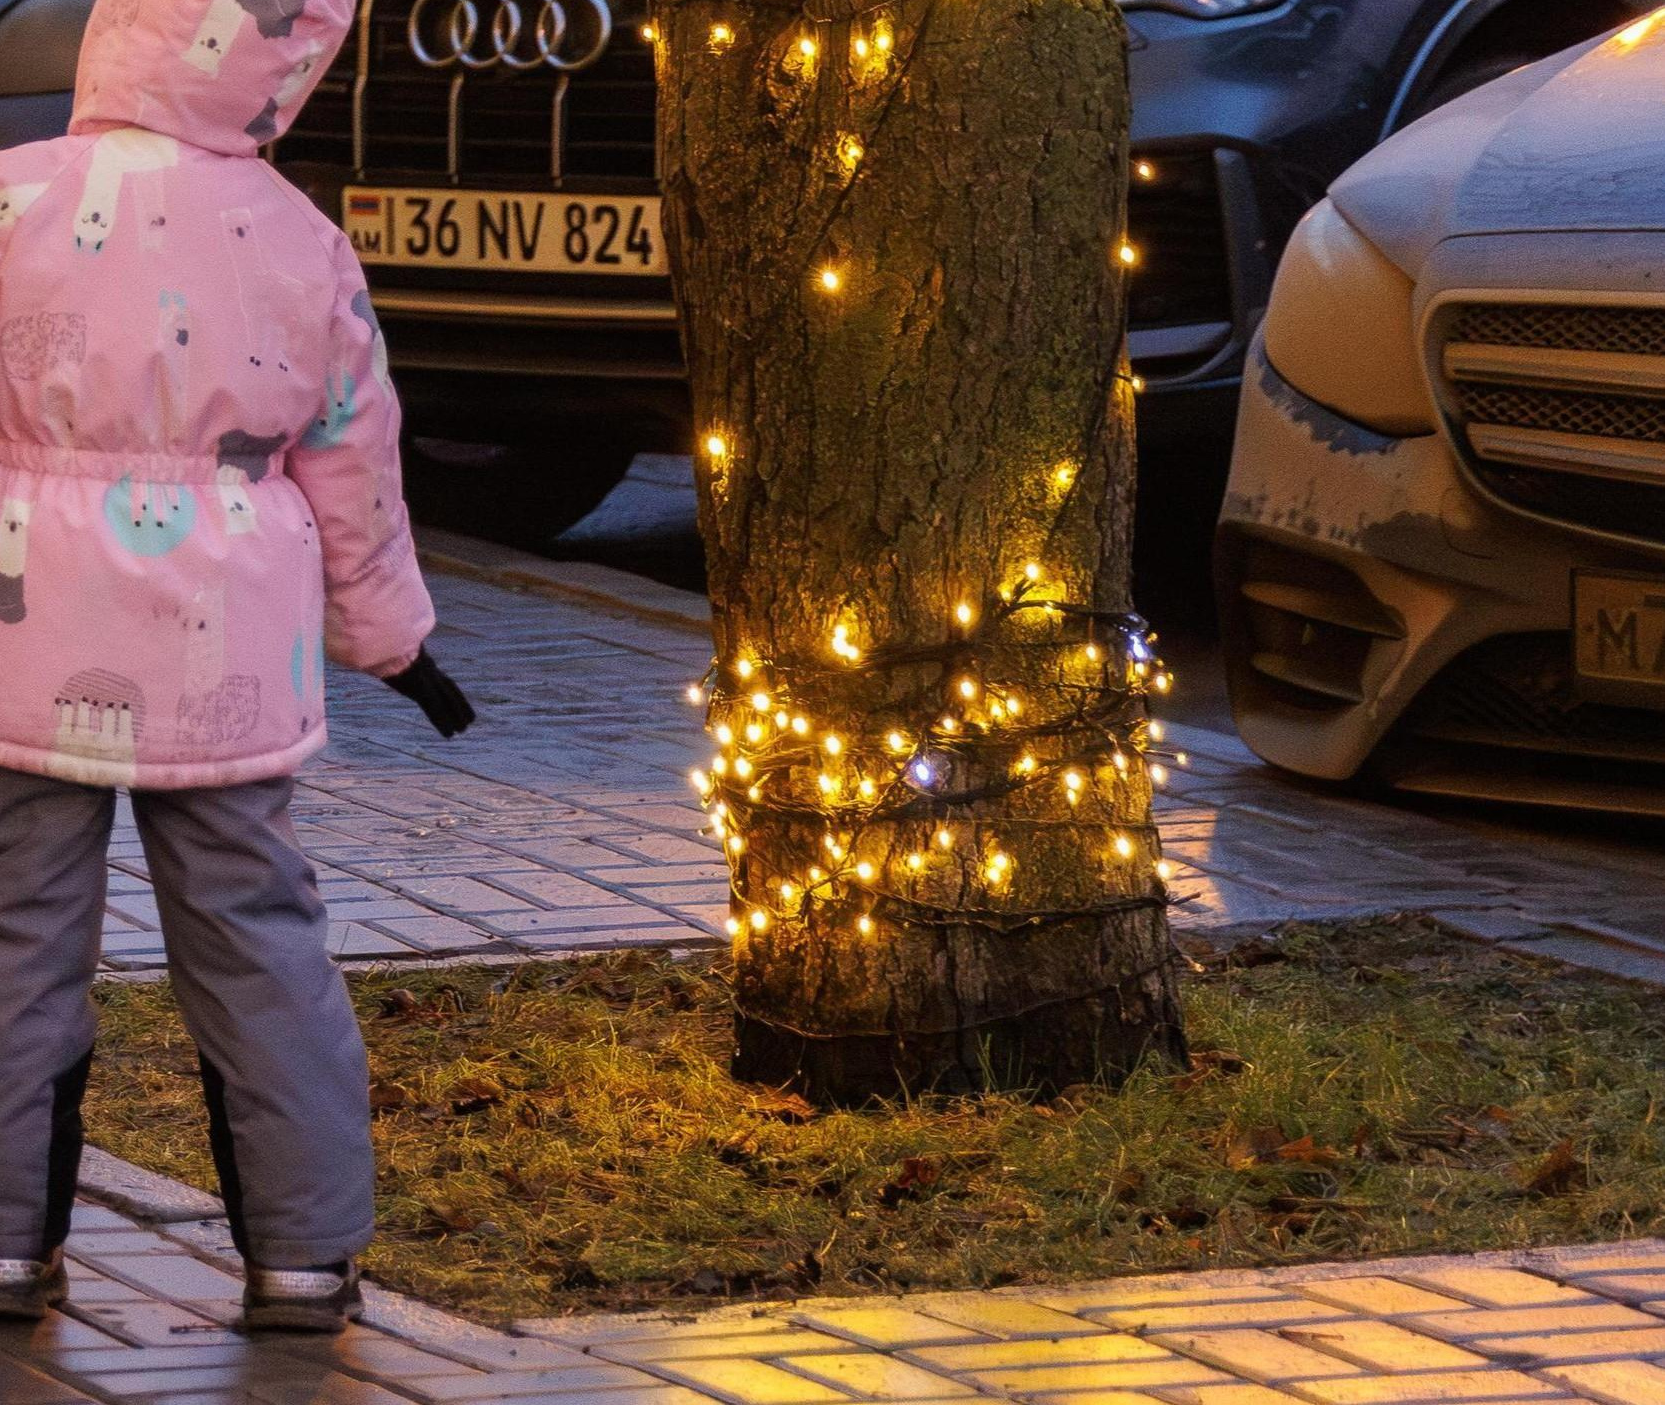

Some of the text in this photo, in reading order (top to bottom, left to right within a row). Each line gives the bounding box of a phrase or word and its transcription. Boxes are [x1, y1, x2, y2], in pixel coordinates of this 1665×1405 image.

[405, 197, 461, 258] 36
[477, 199, 545, 262] NV
[564, 202, 654, 266] 824
